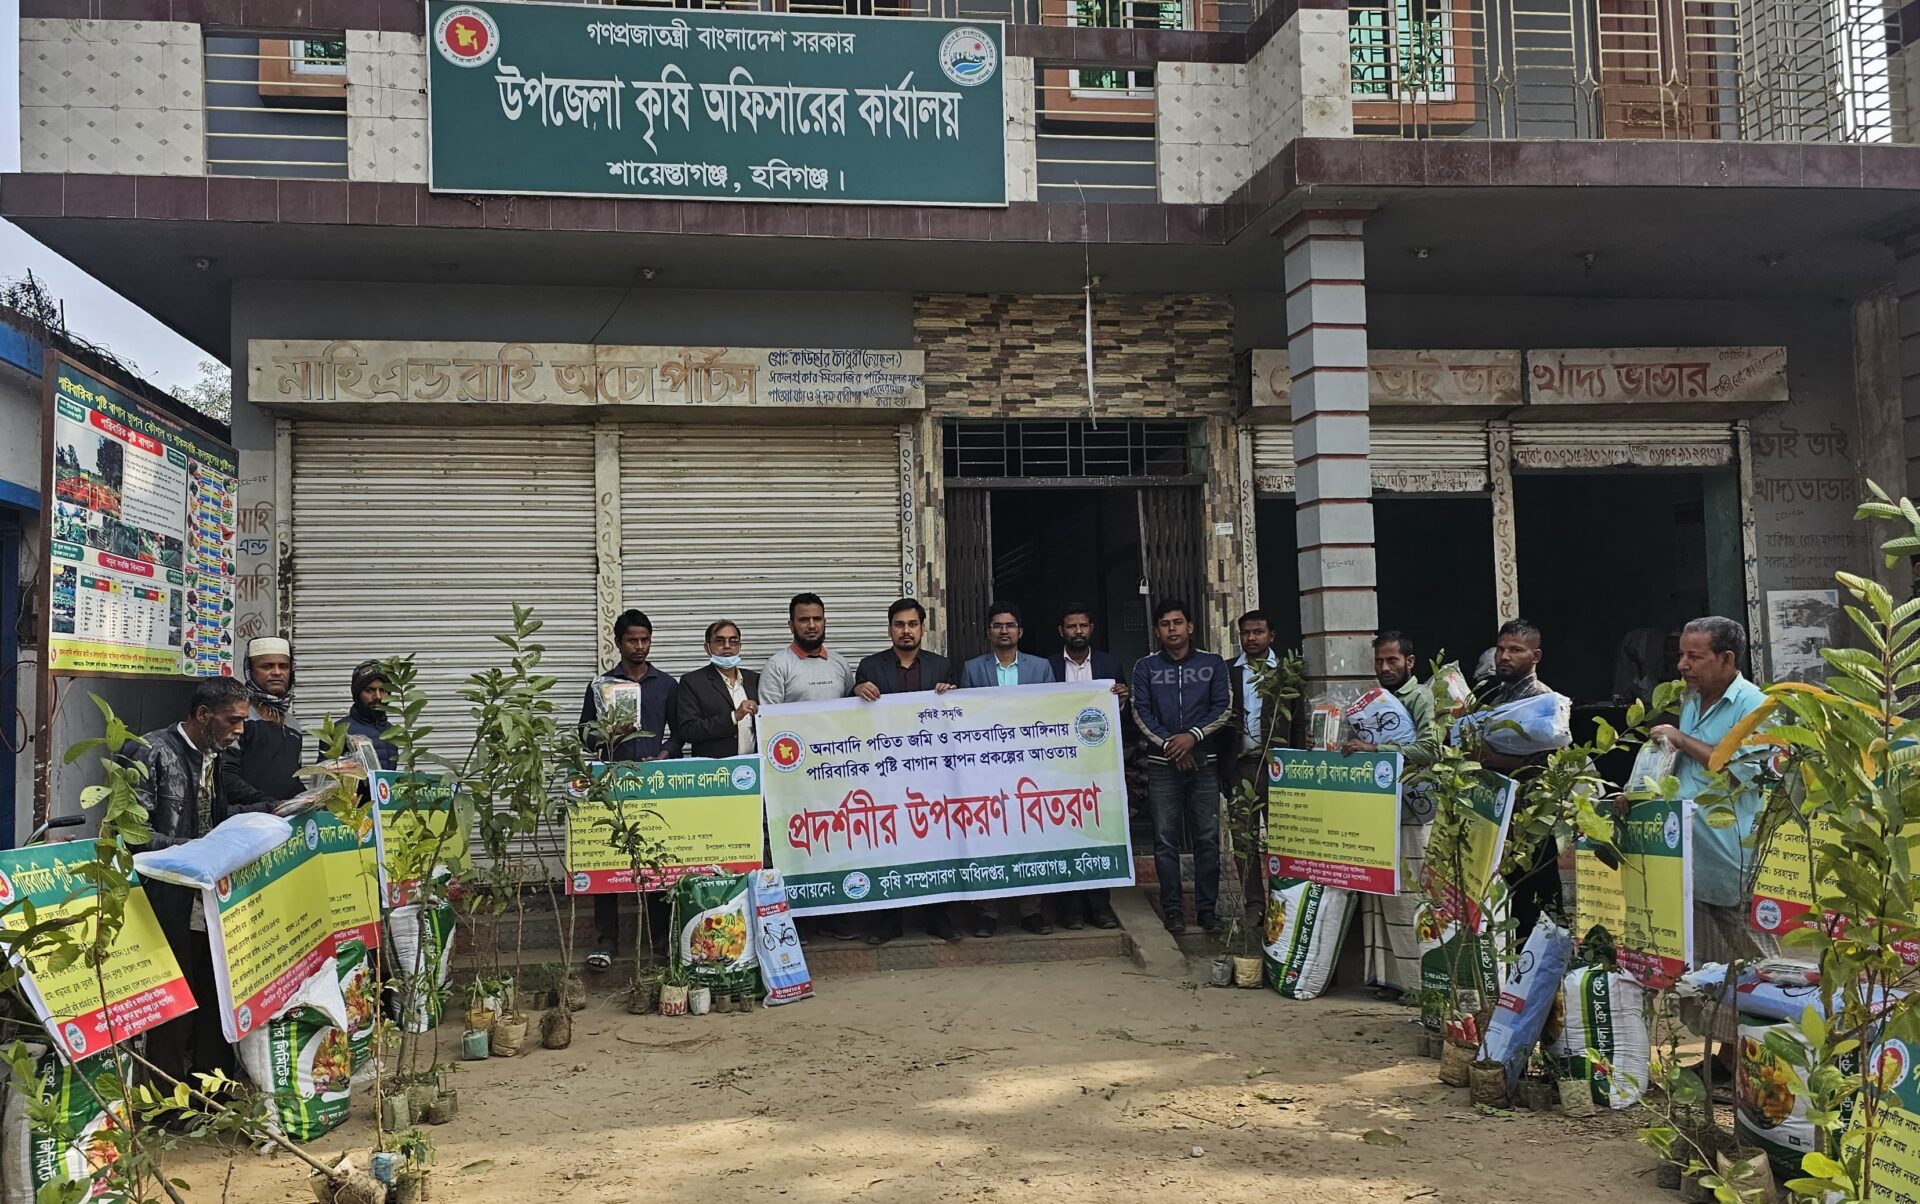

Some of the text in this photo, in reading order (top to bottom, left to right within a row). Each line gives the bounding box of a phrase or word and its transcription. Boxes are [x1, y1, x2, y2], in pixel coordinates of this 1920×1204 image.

[587, 20, 856, 56] গণপ্রজাতন্ত্রী বাংলাদেশ সরকার
[494, 56, 964, 155] উপজেলা কৃষি অফিসারের কার্যালয়
[1531, 361, 1608, 399] খাদ্য
[1613, 361, 1712, 399] ভান্ডার
[1150, 666, 1214, 685] ZERO
[916, 706, 964, 722] কৃষিই সমৃদ্ধি
[809, 721, 1070, 757] অনাবাদি পতিত জমি ও বসতবাড়ির আঙ্গিনায়
[648, 766, 731, 795] পুষ্টি বাগান প্রদর্শনী
[806, 744, 1078, 782] পারিবারিক পুষ্টি বাগান স্থাপন প্রকল্পের আওতায়
[1284, 758, 1374, 785] পারিবারিক পুষ্টি বাগান প্রদর্শনী
[787, 776, 1103, 859] প্রদর্শনীর উপকরণ বিতরণ
[785, 879, 836, 901] াস্তবায়নে:
[877, 874, 902, 898] কৃষি
[904, 867, 956, 890] সম্প্রসারণ
[958, 862, 1010, 884] অধিদপ্তর,
[1011, 859, 1072, 881] শায়েস্তাগঞ্জ,
[1591, 999, 1608, 1024] ক্রপ
